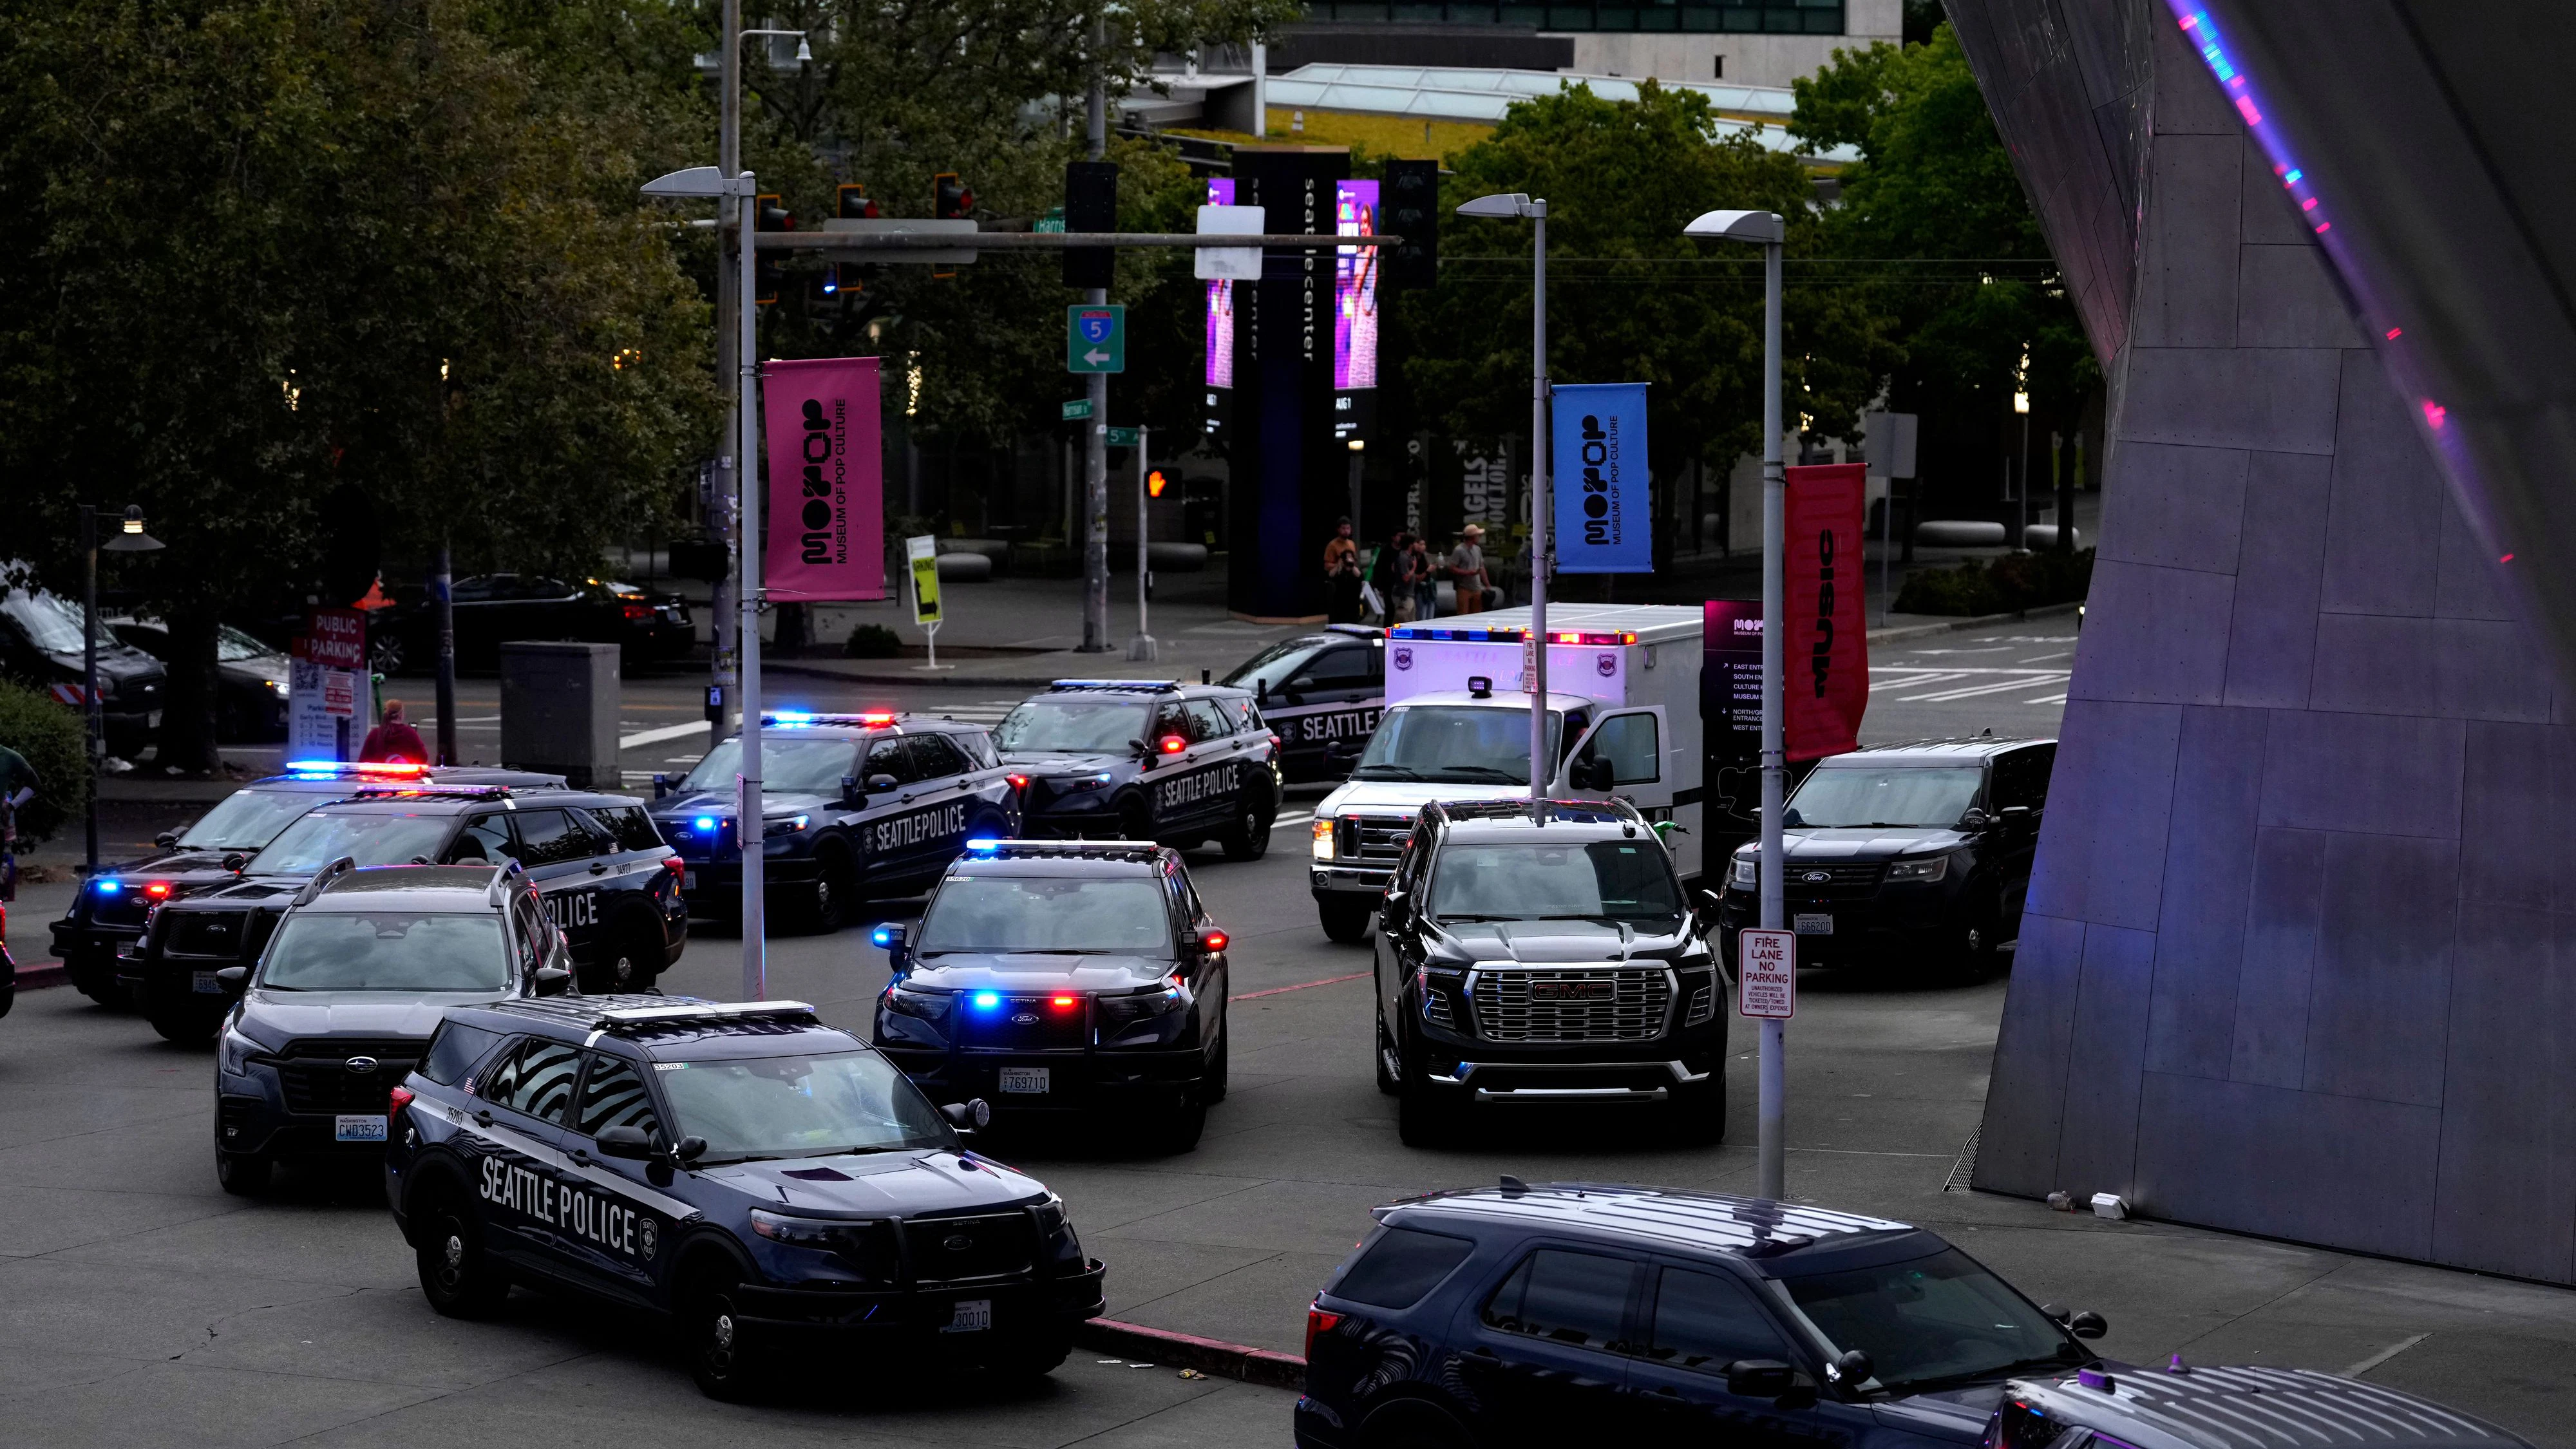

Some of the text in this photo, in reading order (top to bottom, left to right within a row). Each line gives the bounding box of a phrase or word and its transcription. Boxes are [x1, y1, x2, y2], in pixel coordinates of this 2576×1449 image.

[1305, 178, 1317, 271] seatle
[1091, 321, 1102, 338] 5
[1609, 415, 1618, 459] CULTURE
[835, 399, 847, 564] MUSEUM OF POP CULTURE
[1612, 483, 1620, 498] OF
[1613, 501, 1621, 545] MUSEUM
[1812, 529, 1834, 699] MUSIC
[316, 614, 357, 634] PUBLIC
[311, 639, 361, 659] PARKING
[1303, 711, 1374, 741] SEATTLE
[1165, 764, 1240, 808] SEATTLE POLICE
[1801, 922, 1830, 931] 66620D
[1755, 938, 1779, 948] FIRE
[1752, 949, 1783, 960] LANE
[1759, 961, 1775, 971] NO
[1746, 972, 1788, 983] PARKING
[1535, 984, 1611, 998] GMC
[1009, 1077, 1046, 1089] 76971D
[446, 1106, 463, 1126] 35203
[339, 1124, 384, 1137] CWD3523
[480, 1155, 635, 1255] SEATTLE POLICE
[643, 1221, 656, 1233] SEATTLE
